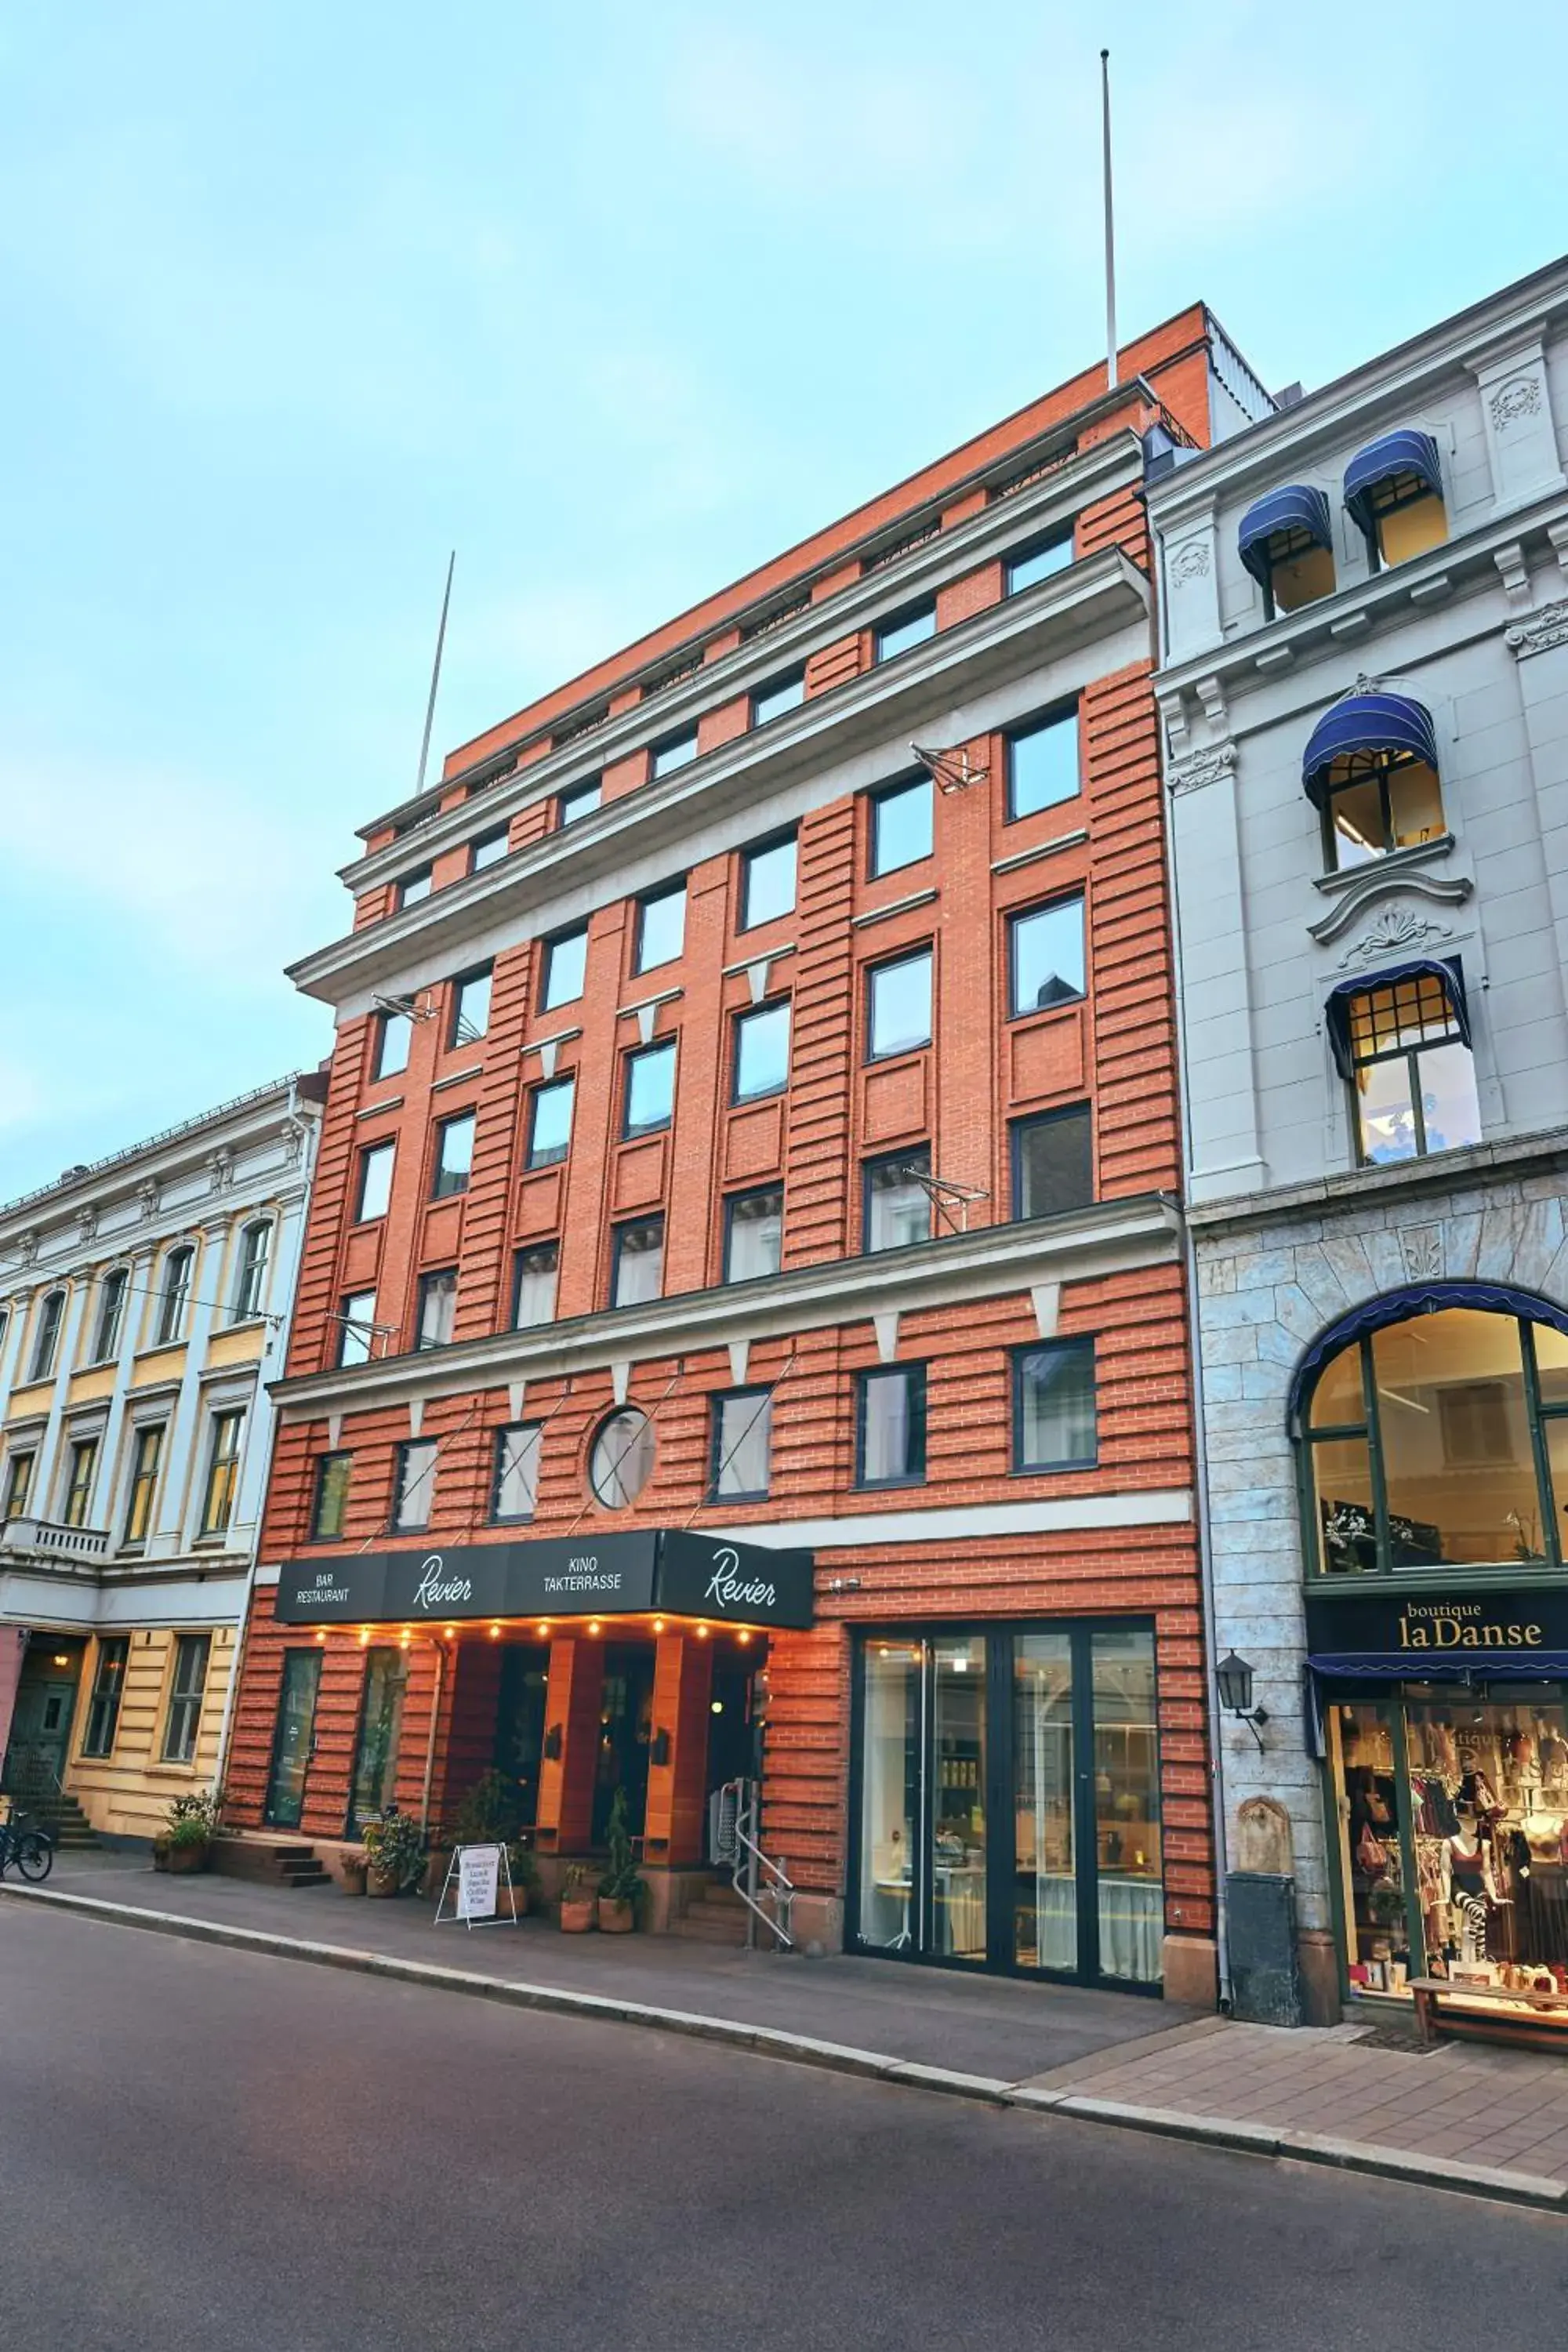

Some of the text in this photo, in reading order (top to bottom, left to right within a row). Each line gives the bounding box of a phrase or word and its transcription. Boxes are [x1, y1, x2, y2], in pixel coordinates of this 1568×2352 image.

[568, 1556, 598, 1573] KINO
[316, 1573, 333, 1587] BAR
[413, 1555, 472, 1609] Revier
[543, 1573, 622, 1592] TAKTERRASSE
[705, 1547, 775, 1608] Revier
[296, 1588, 350, 1604] RESTAURANT
[1408, 1602, 1481, 1621] boutique
[1428, 1730, 1502, 1750] butique
